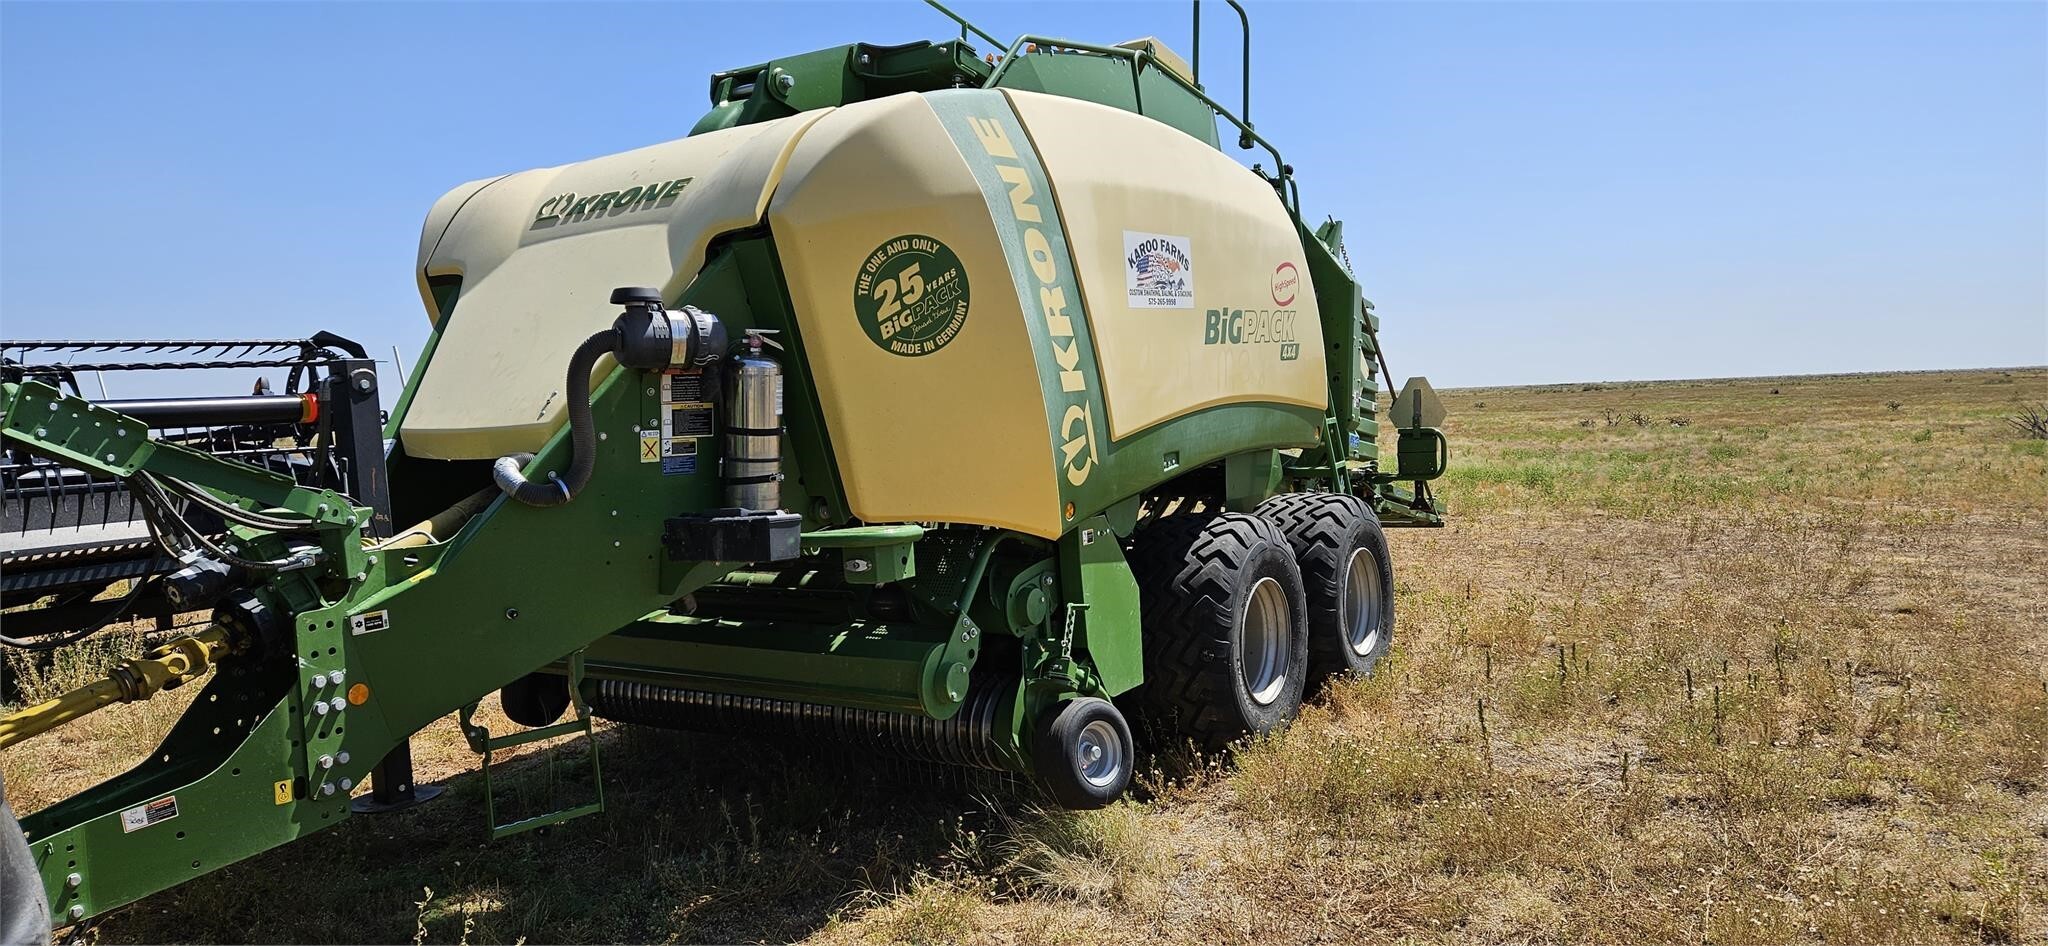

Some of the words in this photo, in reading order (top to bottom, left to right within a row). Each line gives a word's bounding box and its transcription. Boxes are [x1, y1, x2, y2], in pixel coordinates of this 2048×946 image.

[562, 176, 694, 220] KRONE
[858, 273, 872, 295] THE
[866, 250, 887, 273] ONE
[886, 239, 909, 256] AND
[912, 238, 940, 253] ONLY
[967, 116, 1086, 393] KRONE
[1128, 238, 1158, 269] KAROO
[1160, 239, 1190, 271] FARMS
[873, 262, 924, 322] 25
[926, 268, 956, 292] YEARS
[891, 340, 921, 354] MADE
[923, 340, 935, 352] IN
[936, 300, 967, 345] GERMANY
